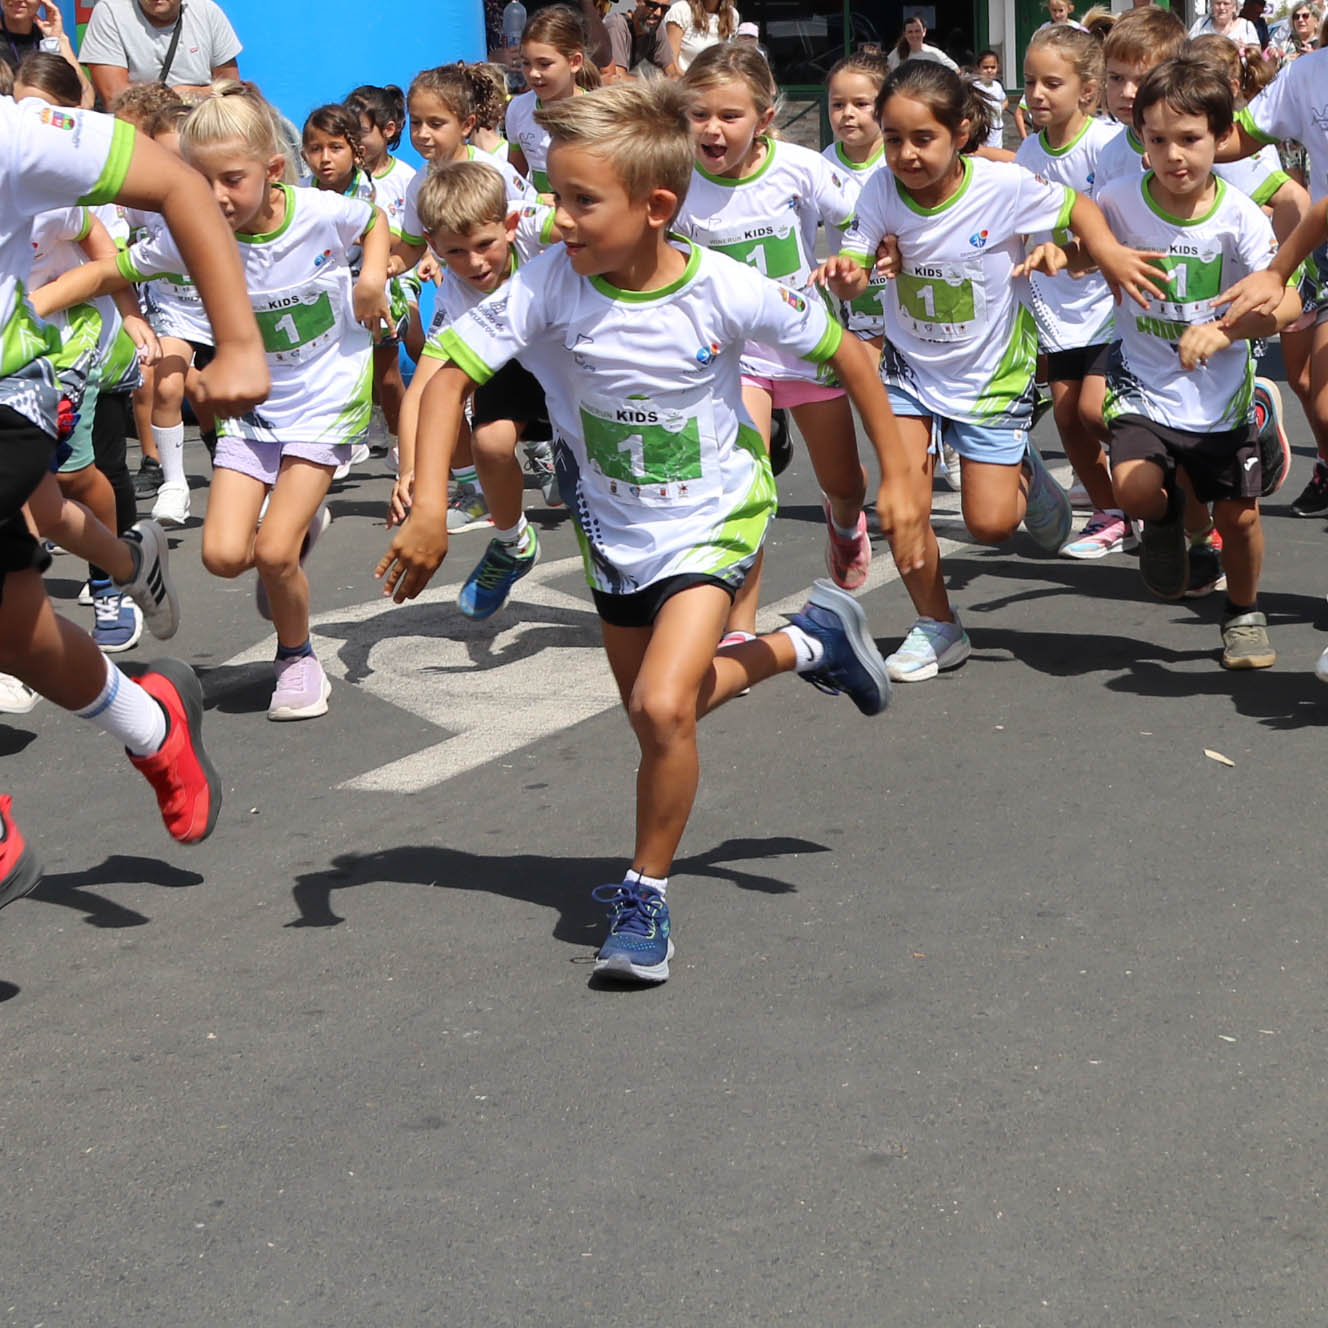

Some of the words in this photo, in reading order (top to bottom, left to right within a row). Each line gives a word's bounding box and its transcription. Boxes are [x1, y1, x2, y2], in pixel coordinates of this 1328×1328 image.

[744, 226, 774, 239] KIDS
[1170, 245, 1198, 255] KIDS
[914, 267, 943, 277] KIDS
[1167, 263, 1187, 297] 1
[268, 295, 299, 309] KIDS
[916, 285, 936, 317] 1
[274, 313, 300, 344] 1
[616, 411, 658, 423] KIDS
[617, 434, 644, 476] 1
